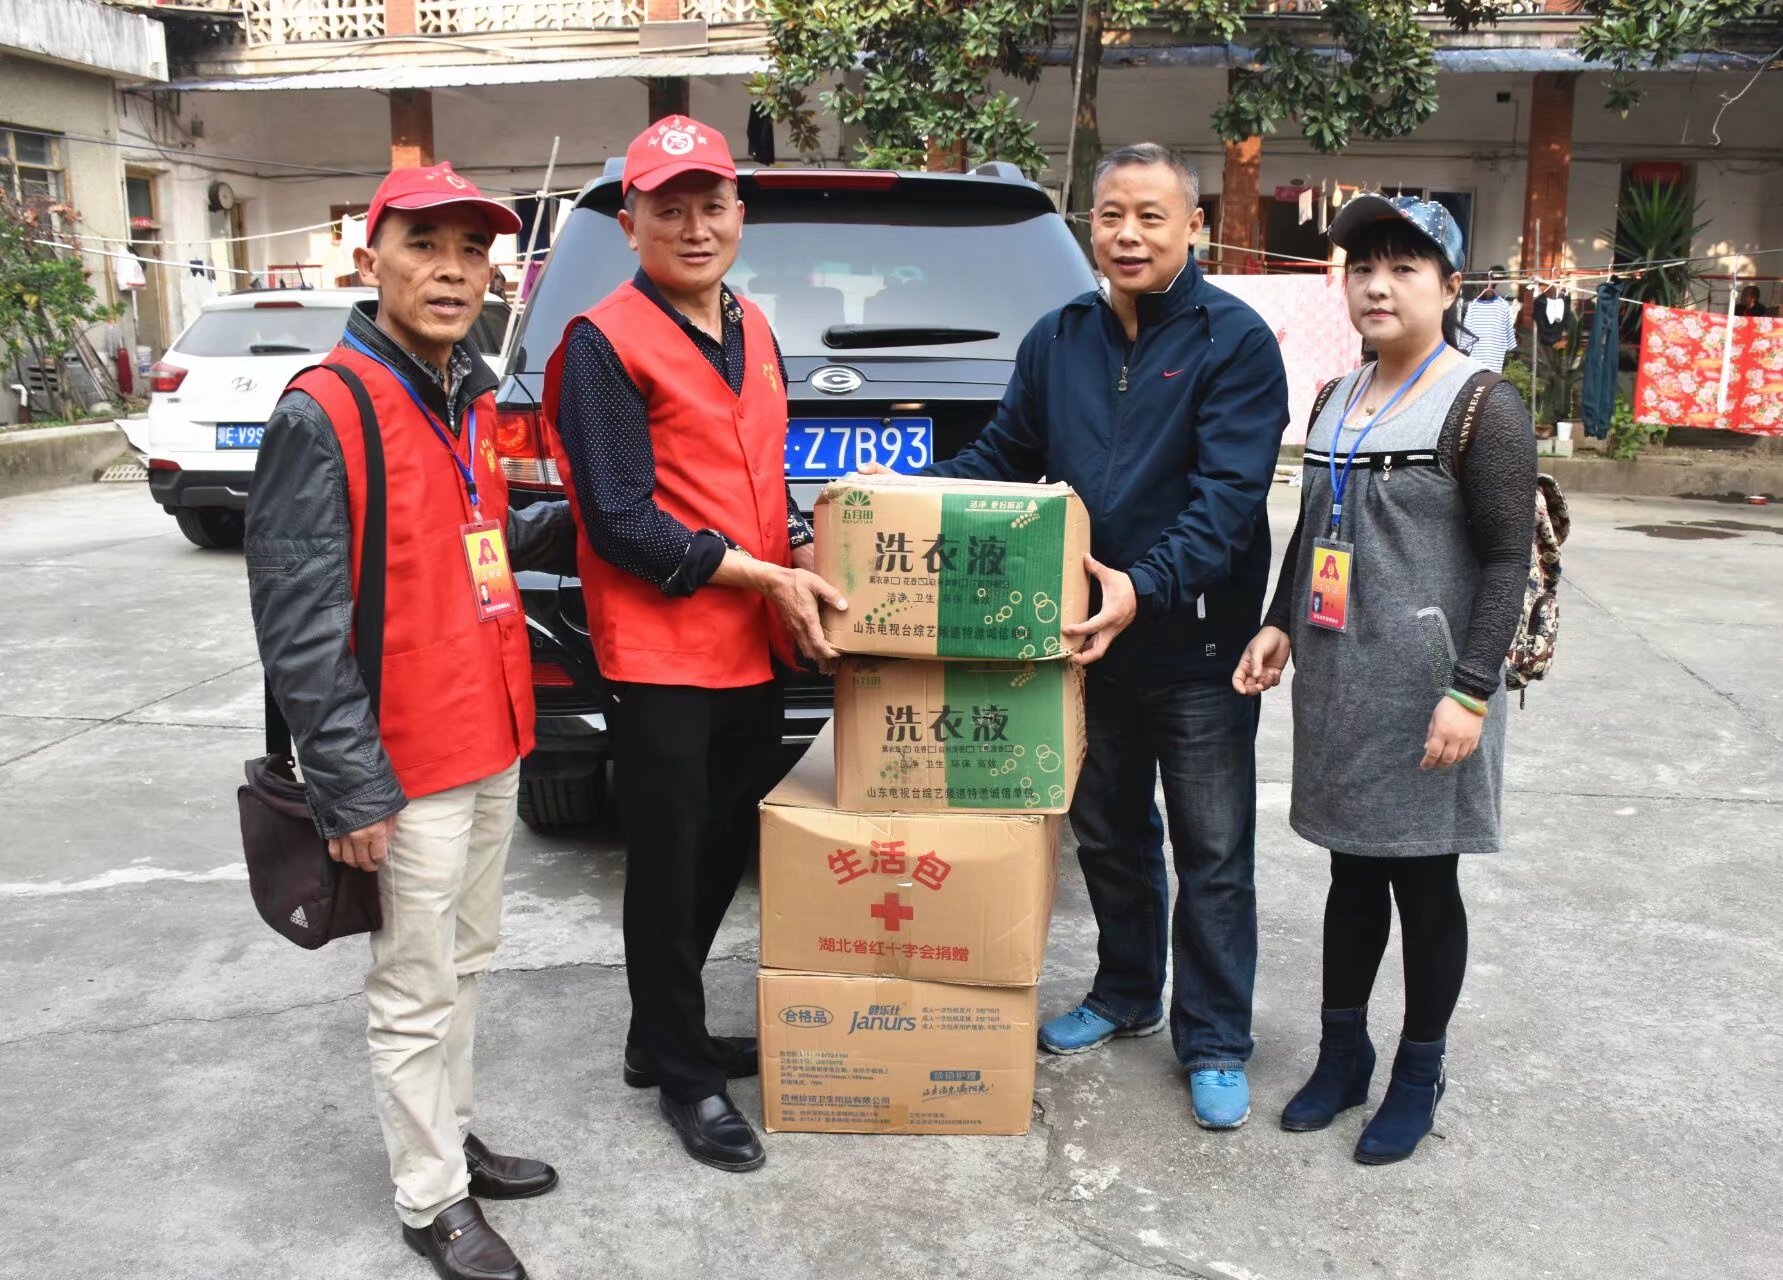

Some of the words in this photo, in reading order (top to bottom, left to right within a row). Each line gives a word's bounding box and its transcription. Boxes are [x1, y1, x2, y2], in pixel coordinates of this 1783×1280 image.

[1467, 385, 1486, 412] BEAR
[841, 509, 874, 520] 五月田
[875, 531, 1007, 577] 洗衣液
[885, 704, 1009, 743] 洗衣液
[827, 840, 952, 891] 生活包
[818, 936, 969, 962] 湖北省红十字会捐赠
[783, 1008, 828, 1024] 合格品
[848, 1011, 917, 1035] Janurs
